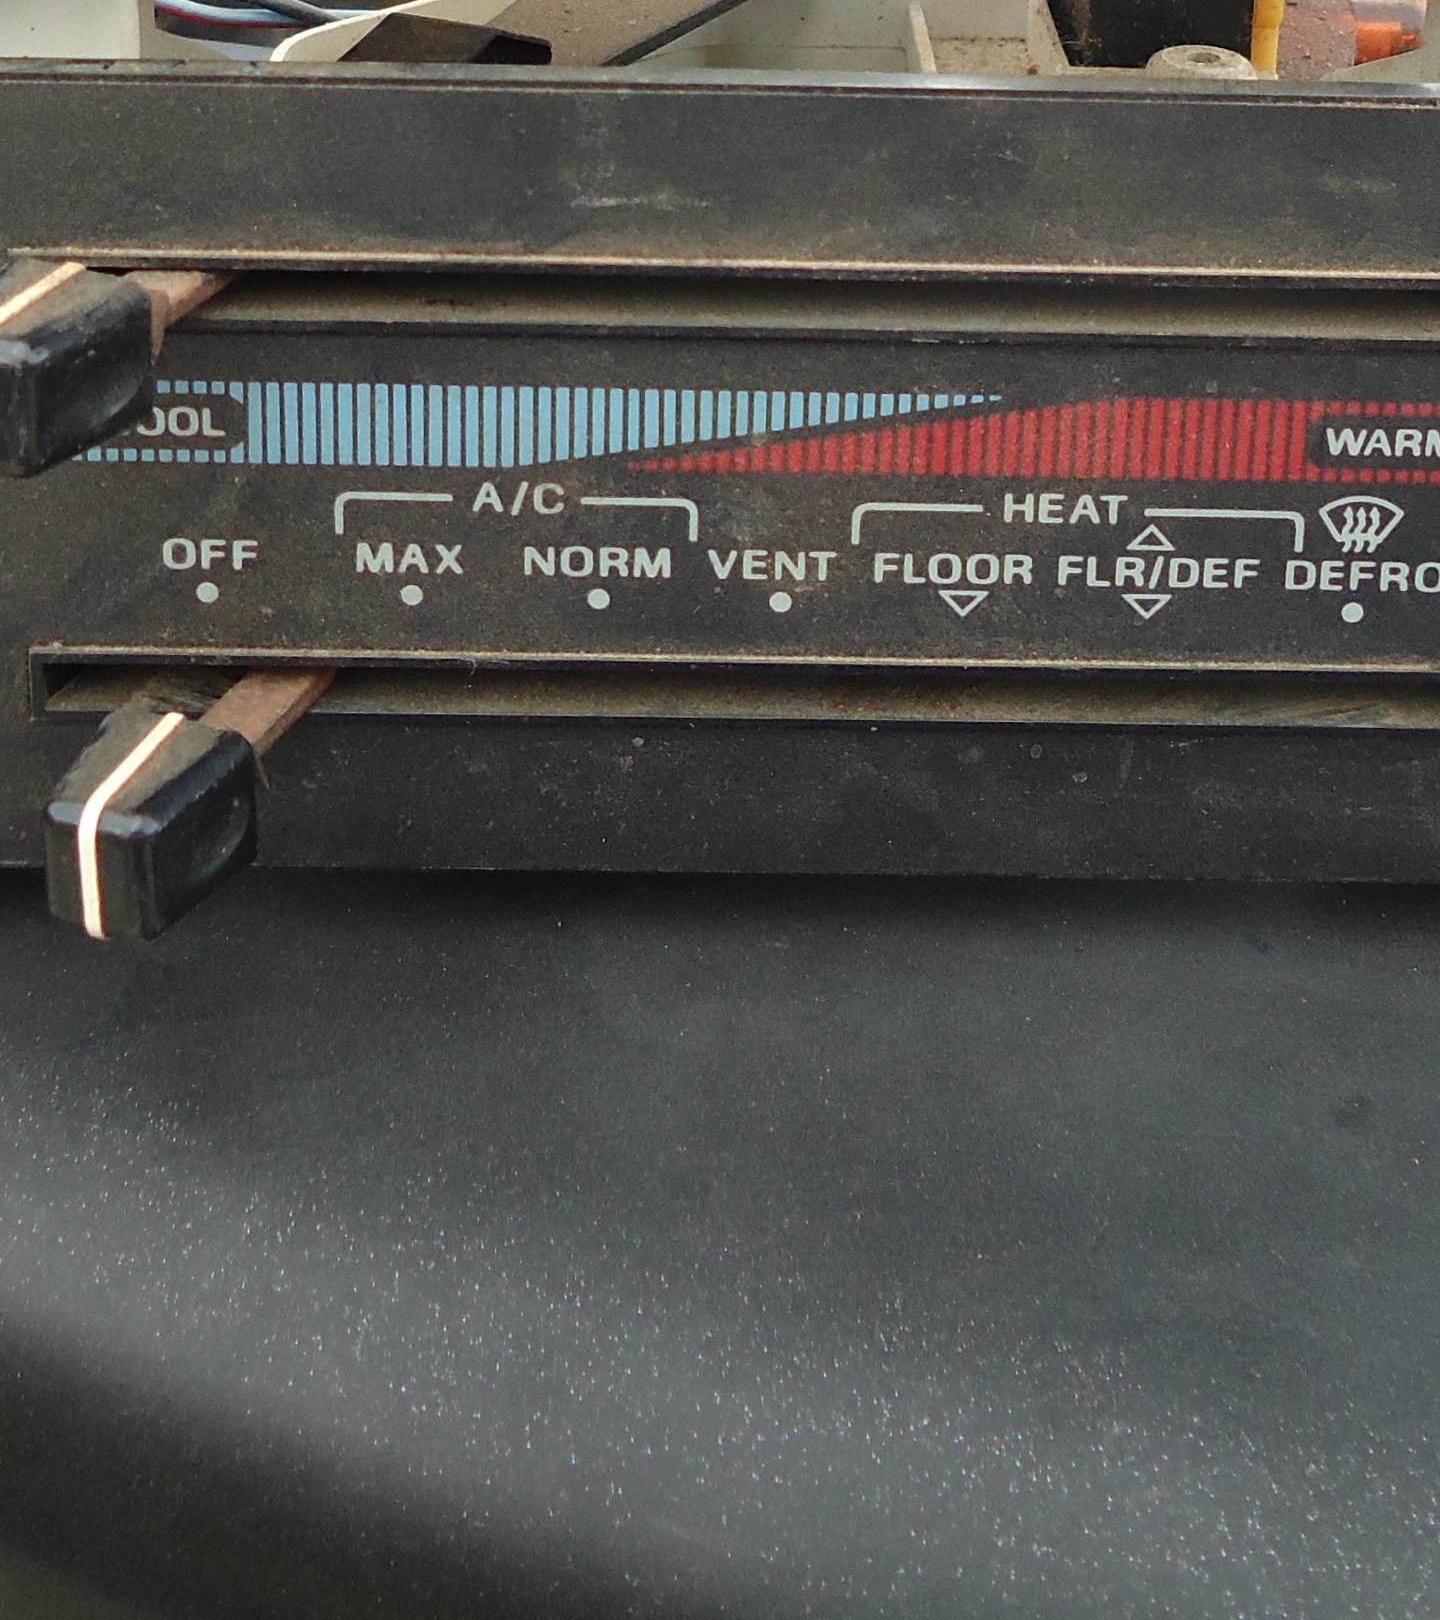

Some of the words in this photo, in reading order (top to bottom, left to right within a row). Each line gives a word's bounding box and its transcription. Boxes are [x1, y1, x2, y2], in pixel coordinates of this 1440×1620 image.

[130, 406, 226, 436] OOL
[473, 481, 564, 515] A/C
[1004, 493, 1128, 524] HEAT
[163, 538, 258, 570] OFF
[356, 543, 463, 574] MAX
[524, 546, 670, 578] NORM
[708, 550, 837, 581] VENT
[875, 553, 1032, 584] FLOOR
[1058, 556, 1260, 589] FLR/DEF
